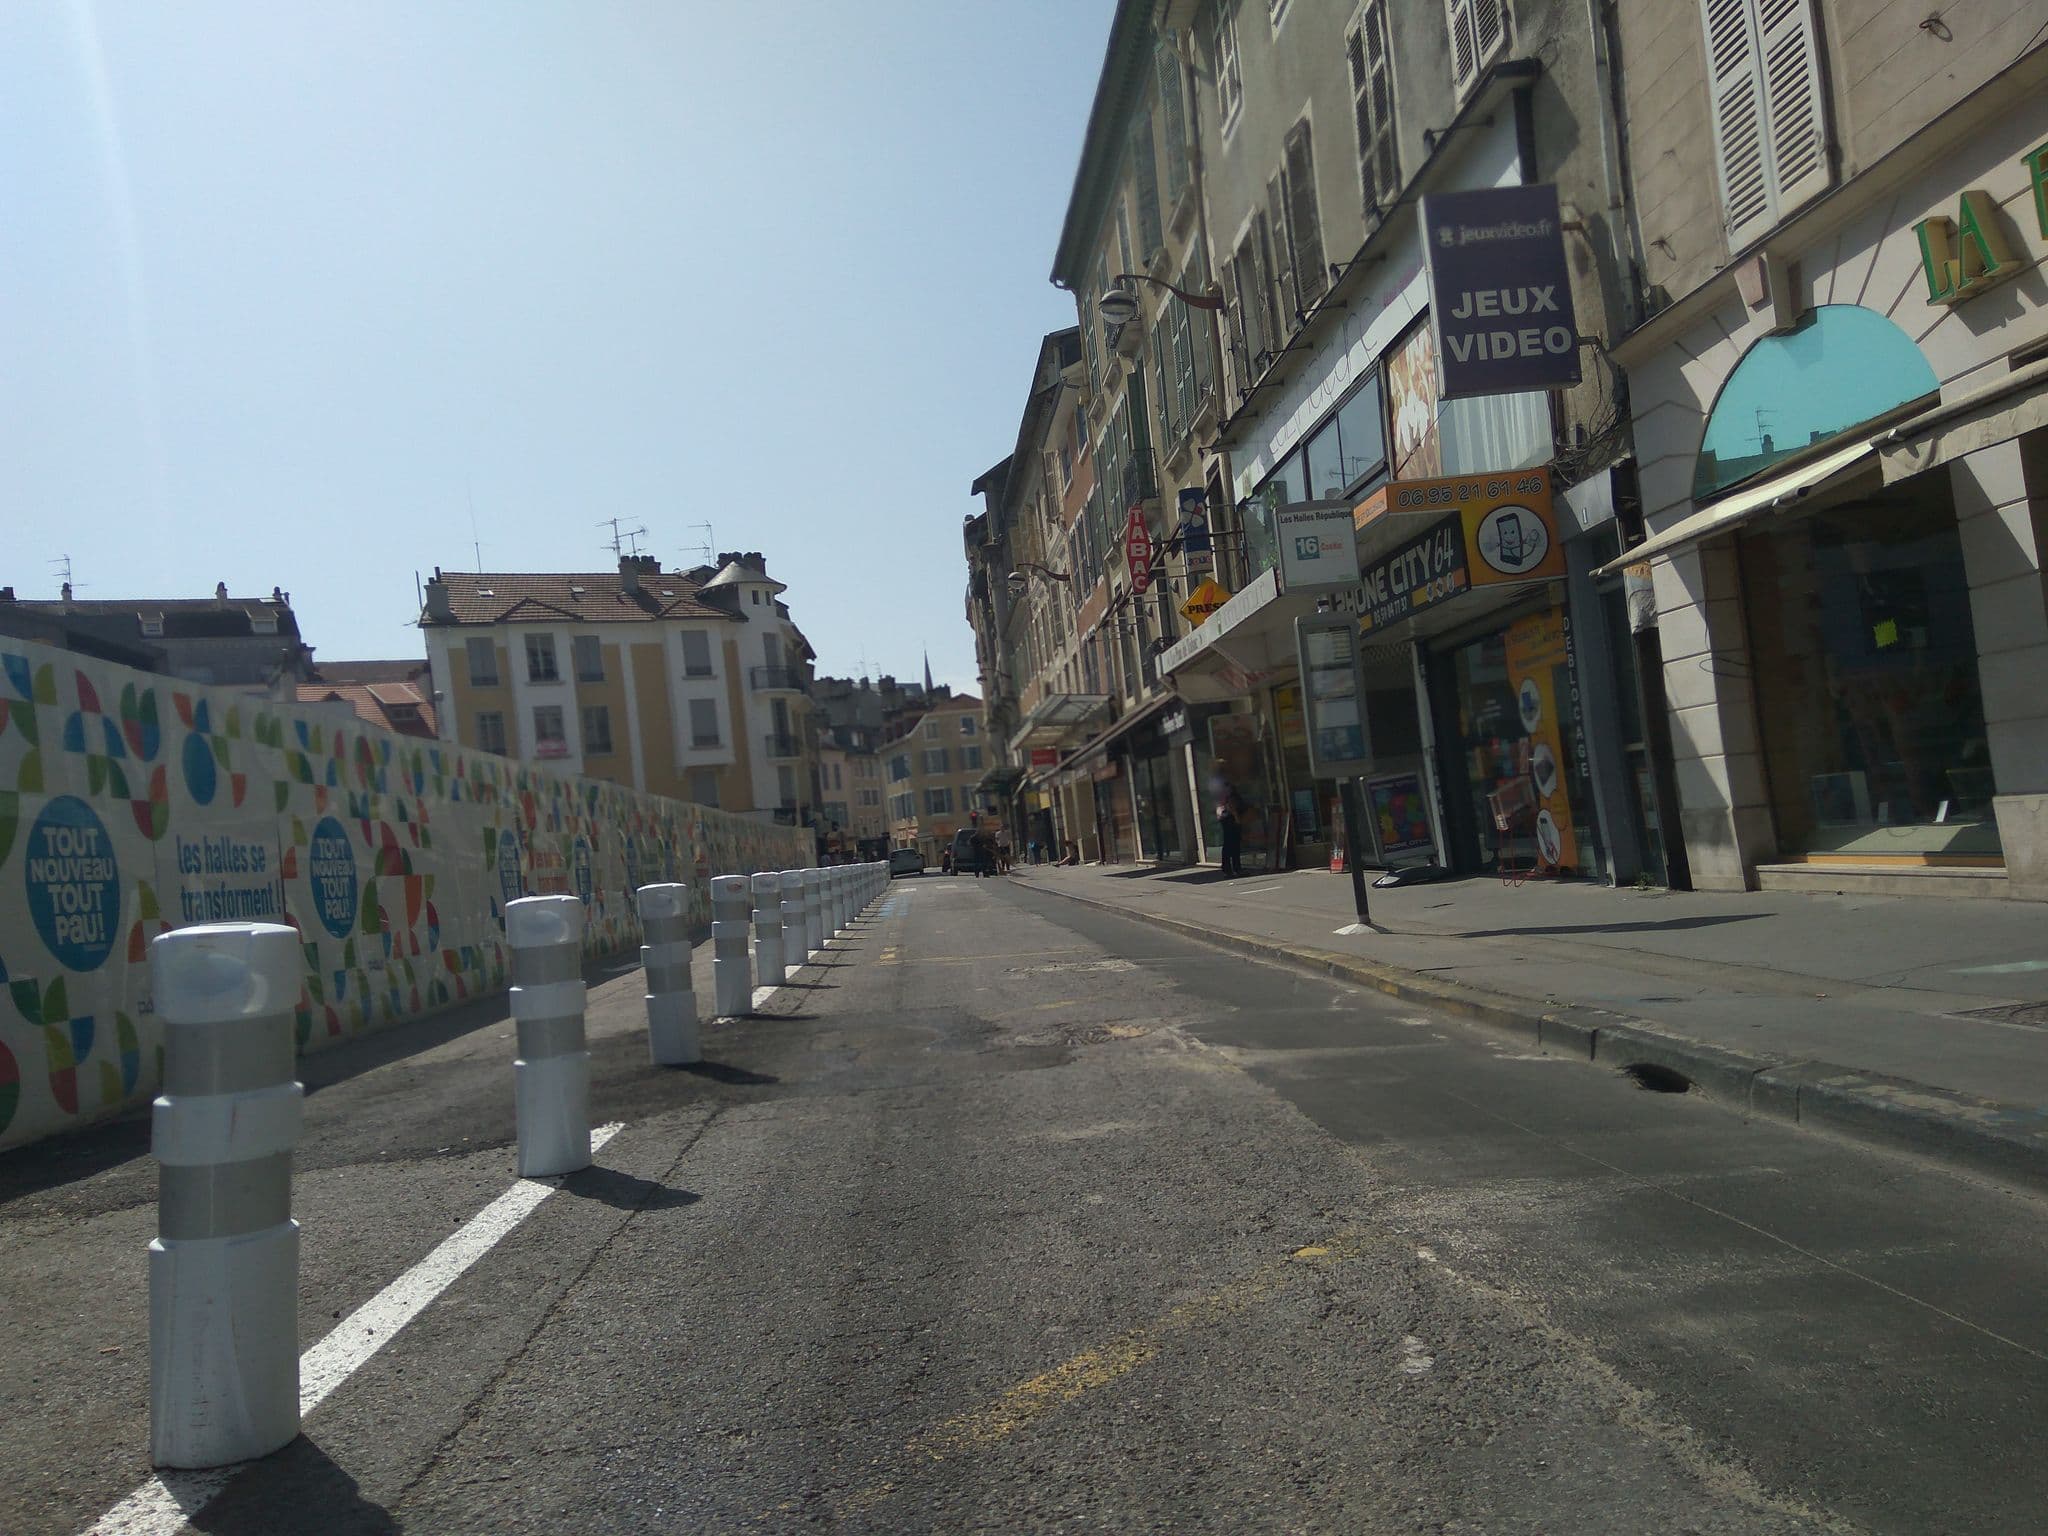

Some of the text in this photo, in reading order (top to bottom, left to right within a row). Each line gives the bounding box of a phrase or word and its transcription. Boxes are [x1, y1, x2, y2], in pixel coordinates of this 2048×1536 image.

[1451, 285, 1560, 319] JEUX
[1446, 326, 1572, 362] VIDEO
[1398, 476, 1543, 507] 06 95 21 61 46
[1129, 509, 1148, 589] TABAC
[1297, 538, 1318, 554] 16
[1390, 539, 1431, 595] CITY
[1434, 527, 1454, 573] 64
[1187, 602, 1226, 615] PRES
[42, 826, 98, 857] TOUT
[176, 834, 266, 874] les halles se
[317, 838, 346, 859] TOUT
[47, 882, 104, 914] TOUT
[181, 881, 274, 922] transforment
[321, 877, 349, 899] TOUT
